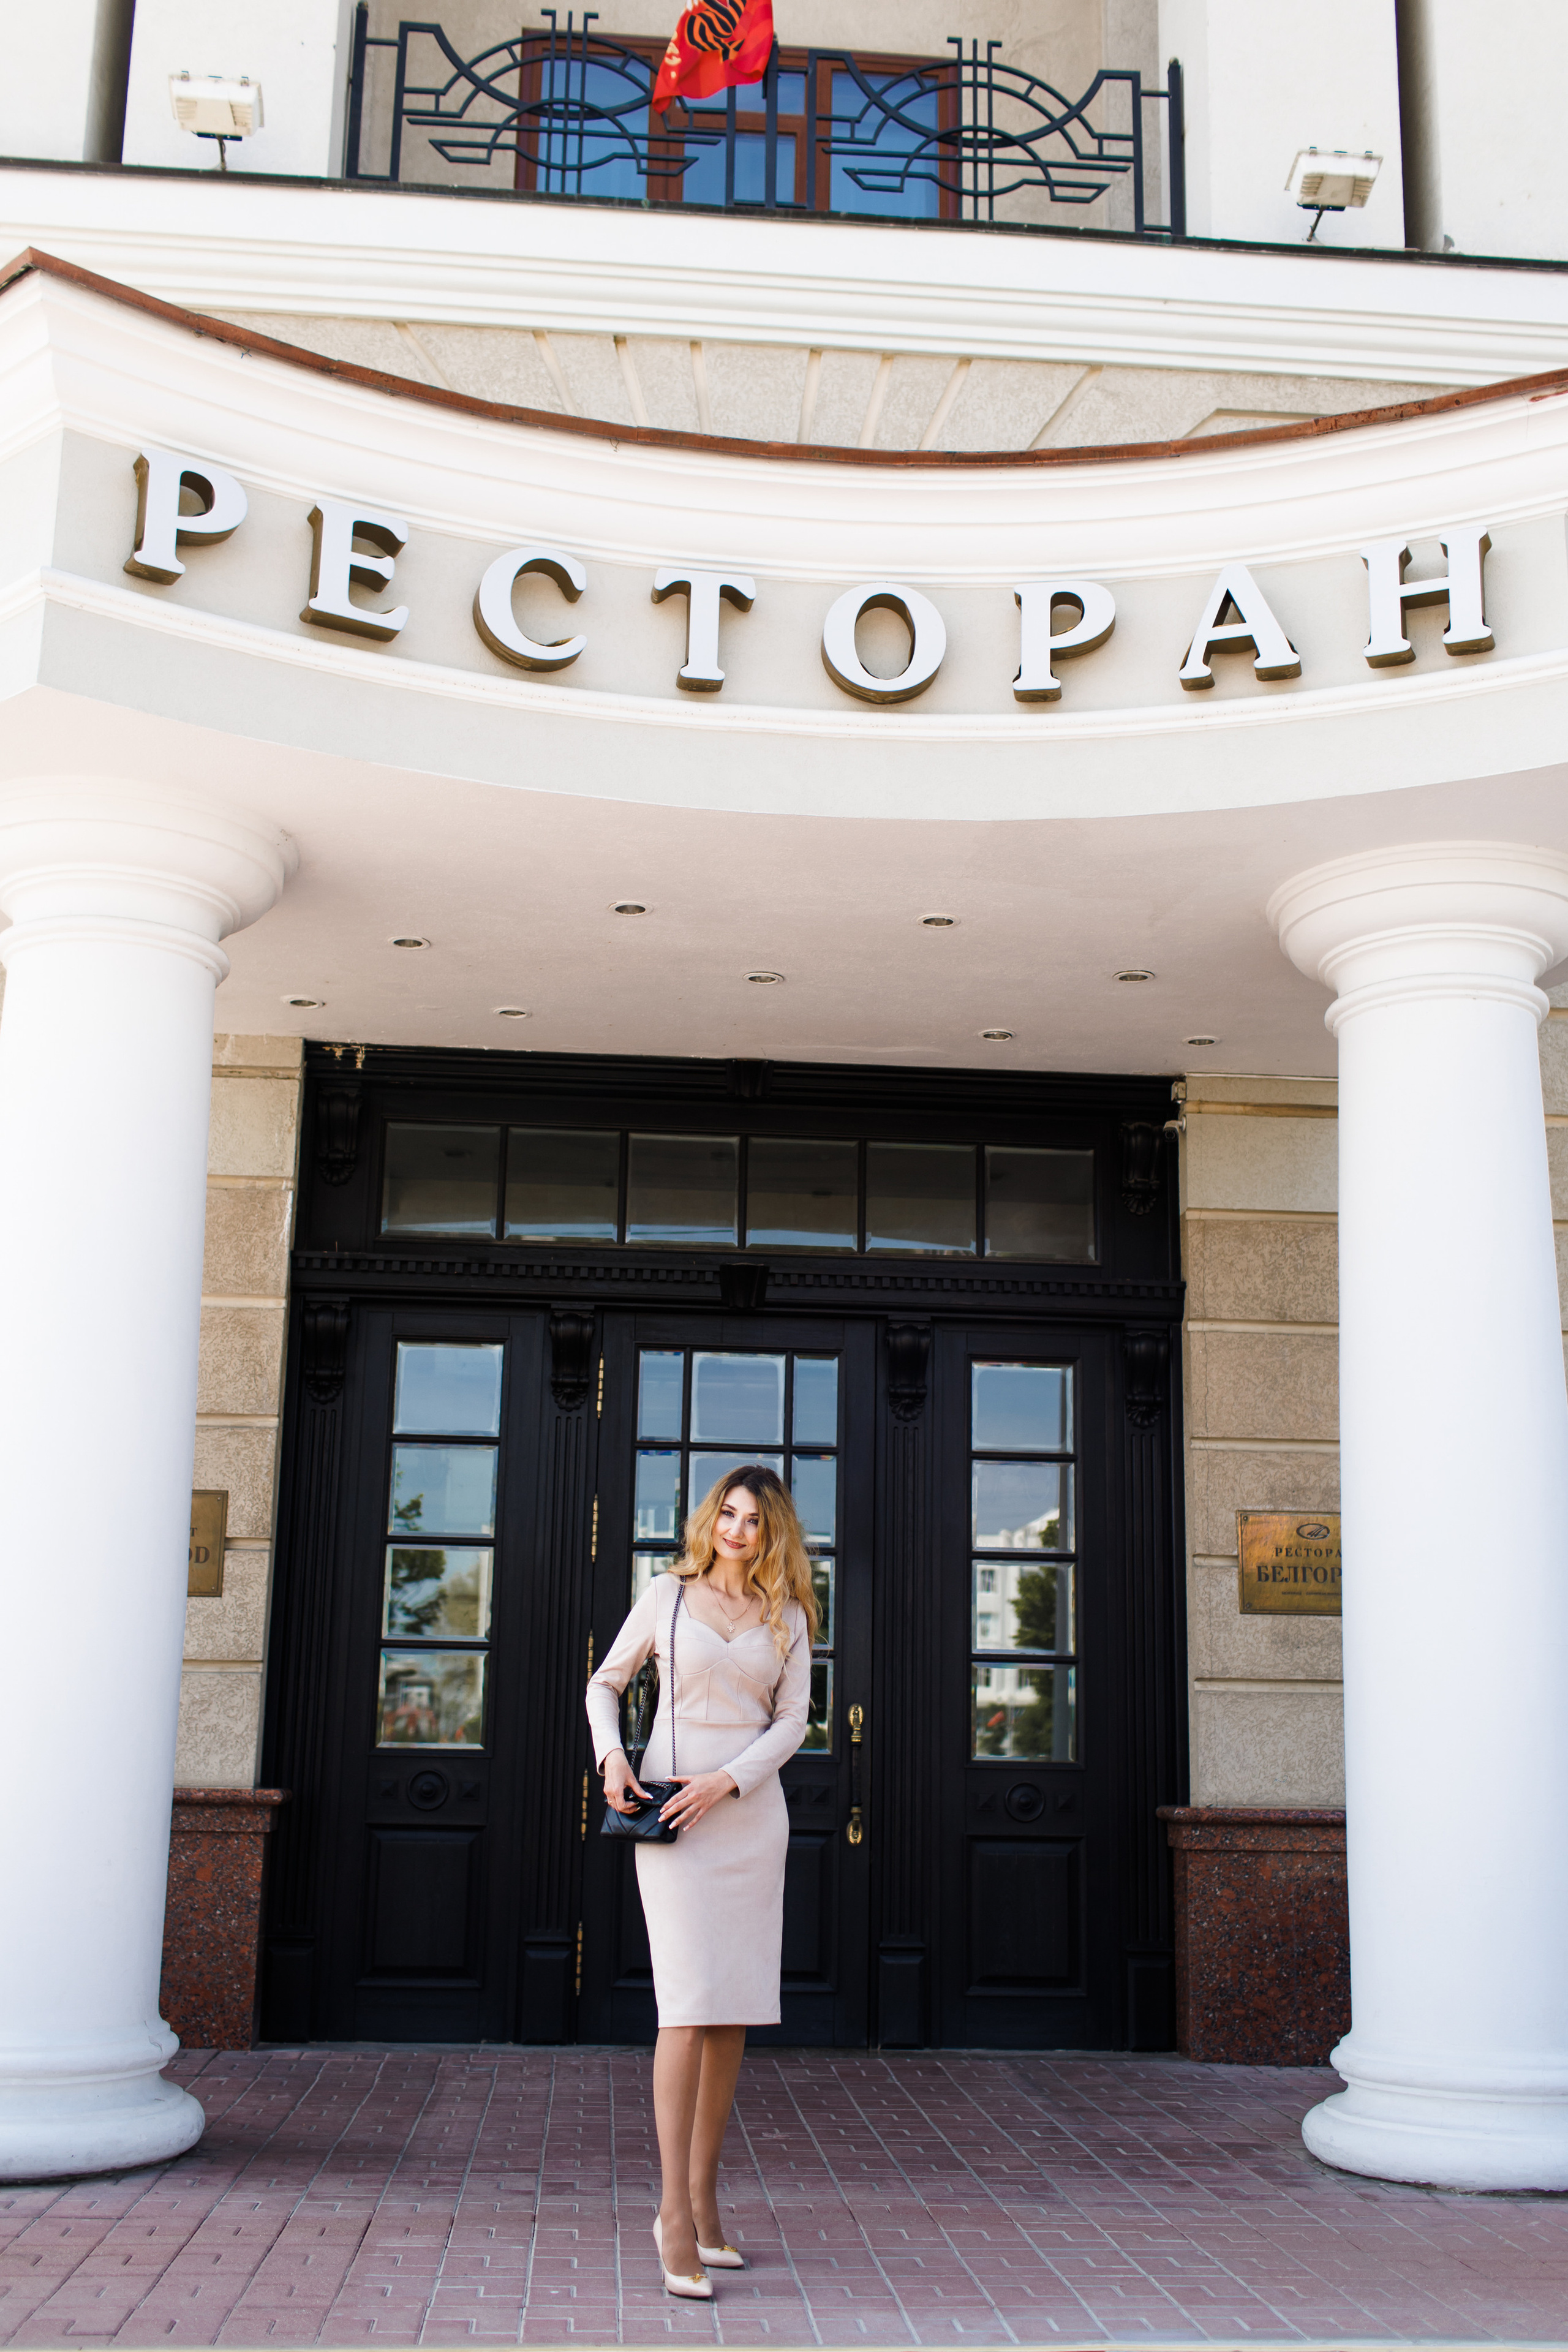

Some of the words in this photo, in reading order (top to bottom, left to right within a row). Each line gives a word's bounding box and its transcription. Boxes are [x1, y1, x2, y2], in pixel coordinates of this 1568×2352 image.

[123, 448, 1495, 704] РЕСТОРАН
[1275, 1547, 1341, 1558] РЕСТОРА
[1257, 1566, 1342, 1583] БЕЛГОР
